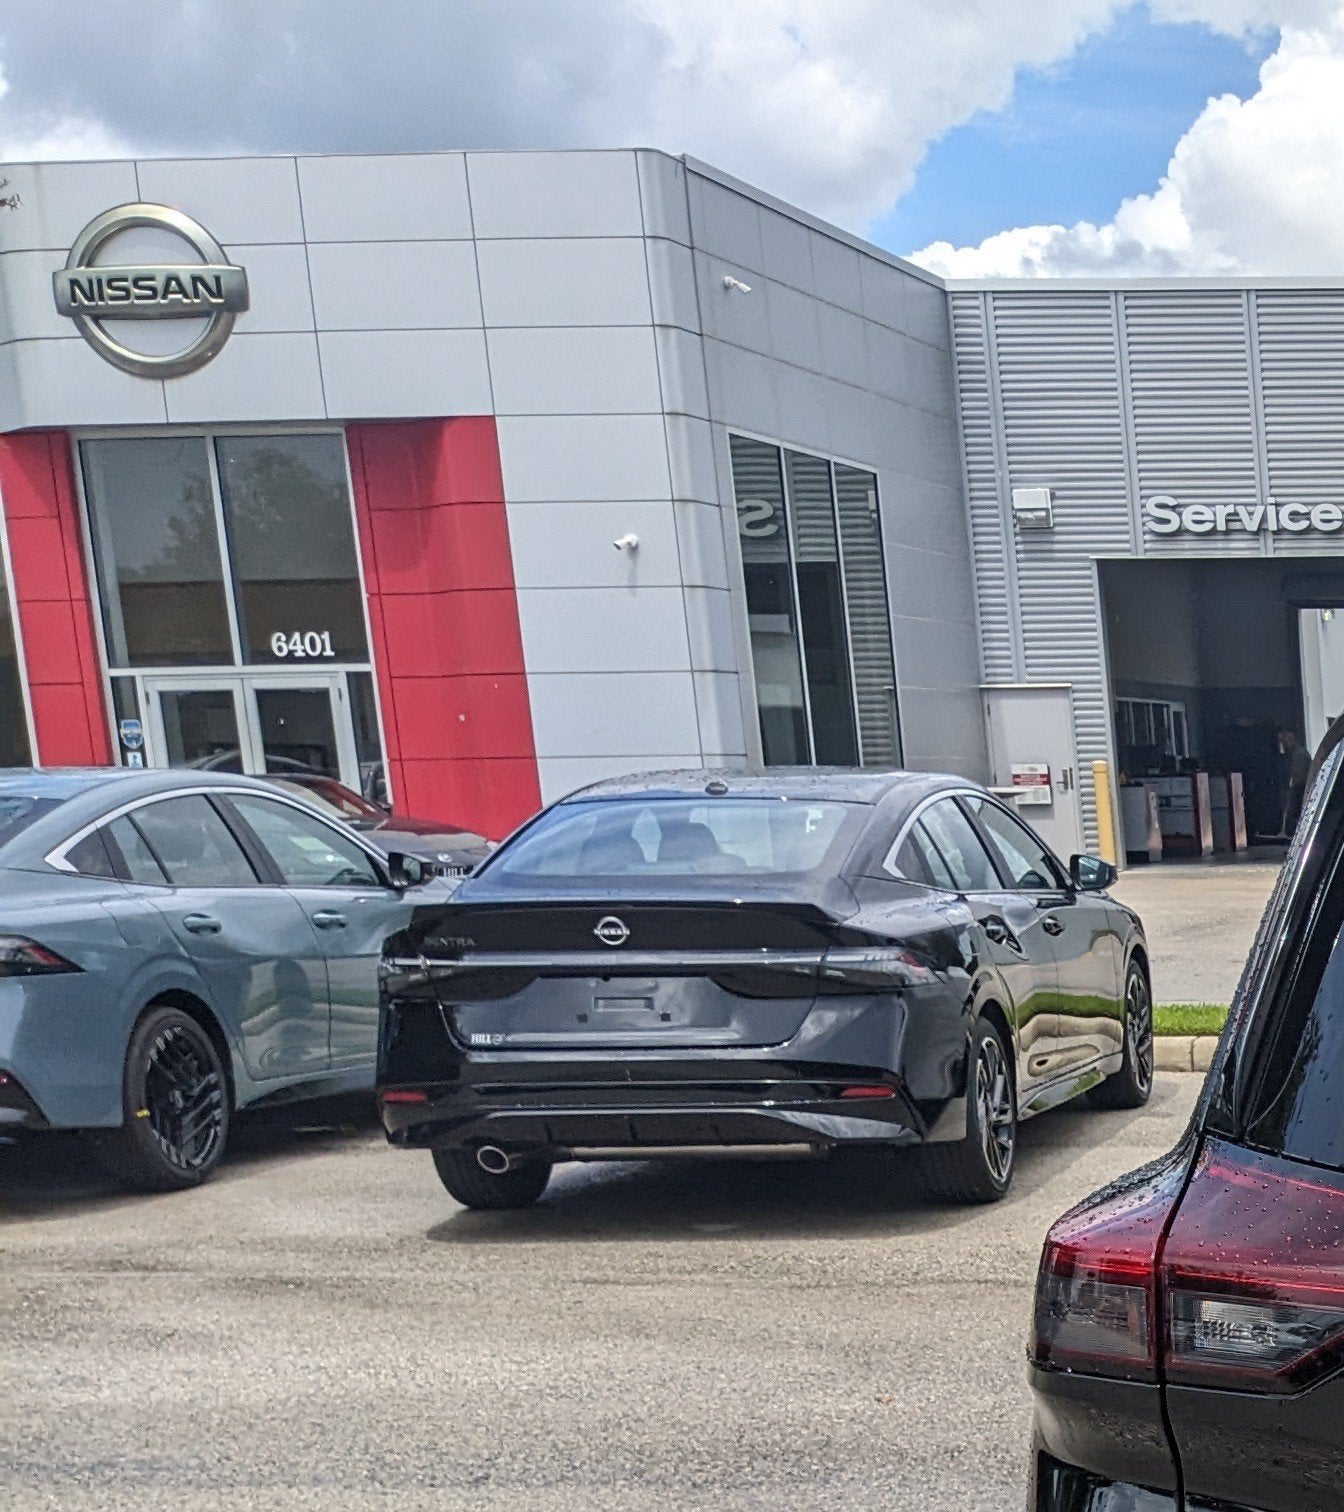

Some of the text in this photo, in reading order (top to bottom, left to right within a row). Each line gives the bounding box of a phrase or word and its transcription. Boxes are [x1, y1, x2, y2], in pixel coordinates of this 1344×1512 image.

[68, 273, 225, 306] NISSAN
[1145, 495, 1344, 533] Service
[271, 630, 336, 657] 6401
